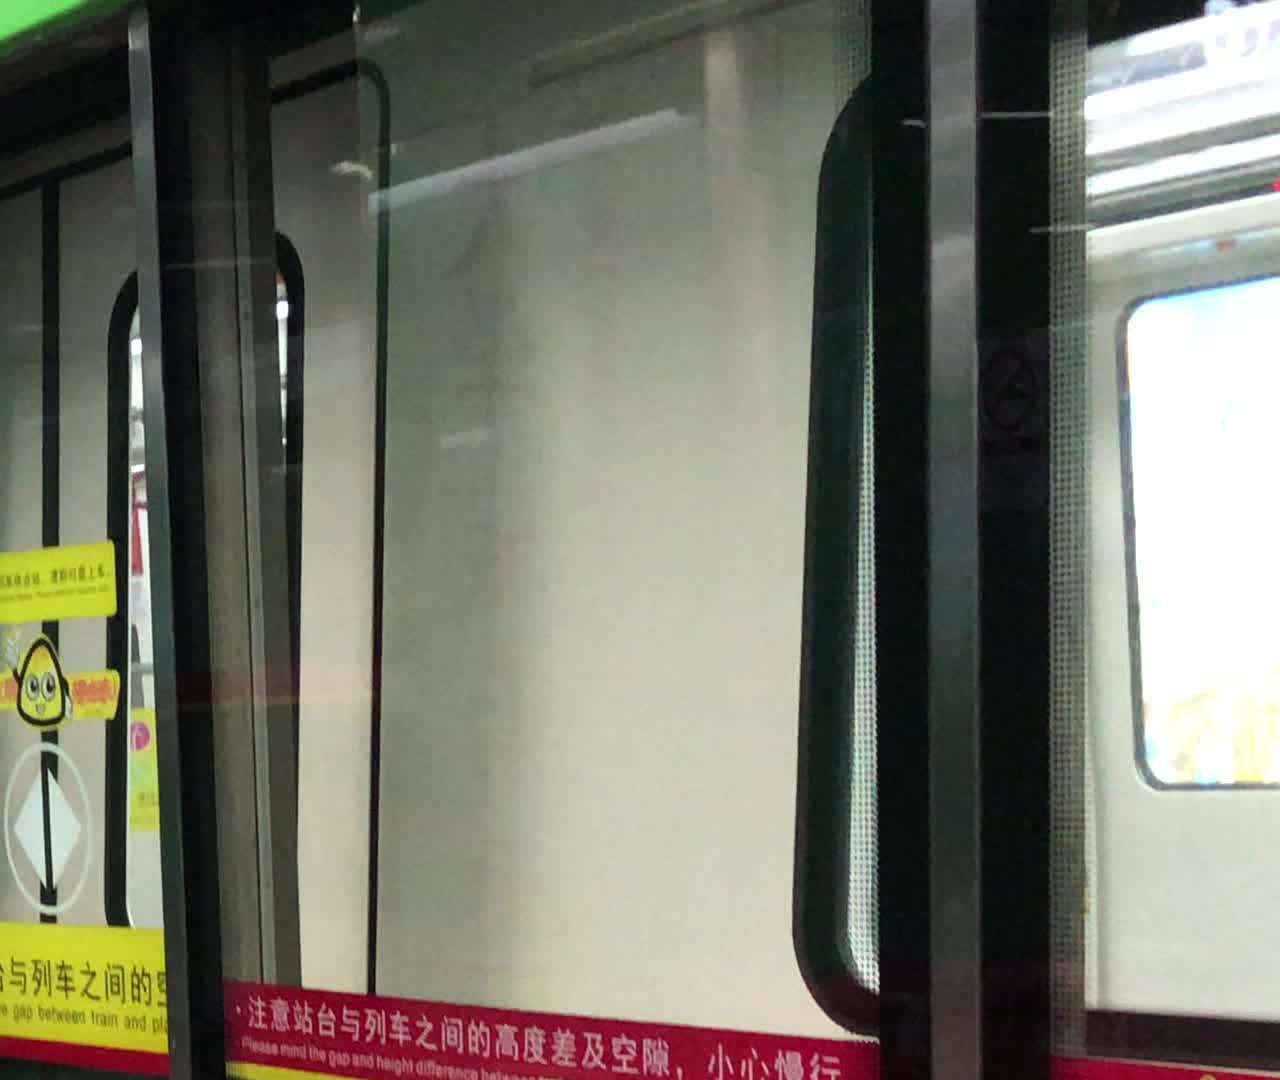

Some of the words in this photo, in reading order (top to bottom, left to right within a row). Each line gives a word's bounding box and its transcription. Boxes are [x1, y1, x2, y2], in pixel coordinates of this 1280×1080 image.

[13, 1005, 34, 1023] gap
[38, 1006, 86, 1026] between
[91, 1010, 119, 1028] train
[124, 1014, 147, 1031] and
[242, 1036, 278, 1053] Please
[280, 1041, 307, 1060] mind
[309, 1045, 327, 1064] the
[328, 1050, 351, 1070] gap
[352, 1053, 375, 1070] and
[377, 1056, 414, 1078] height
